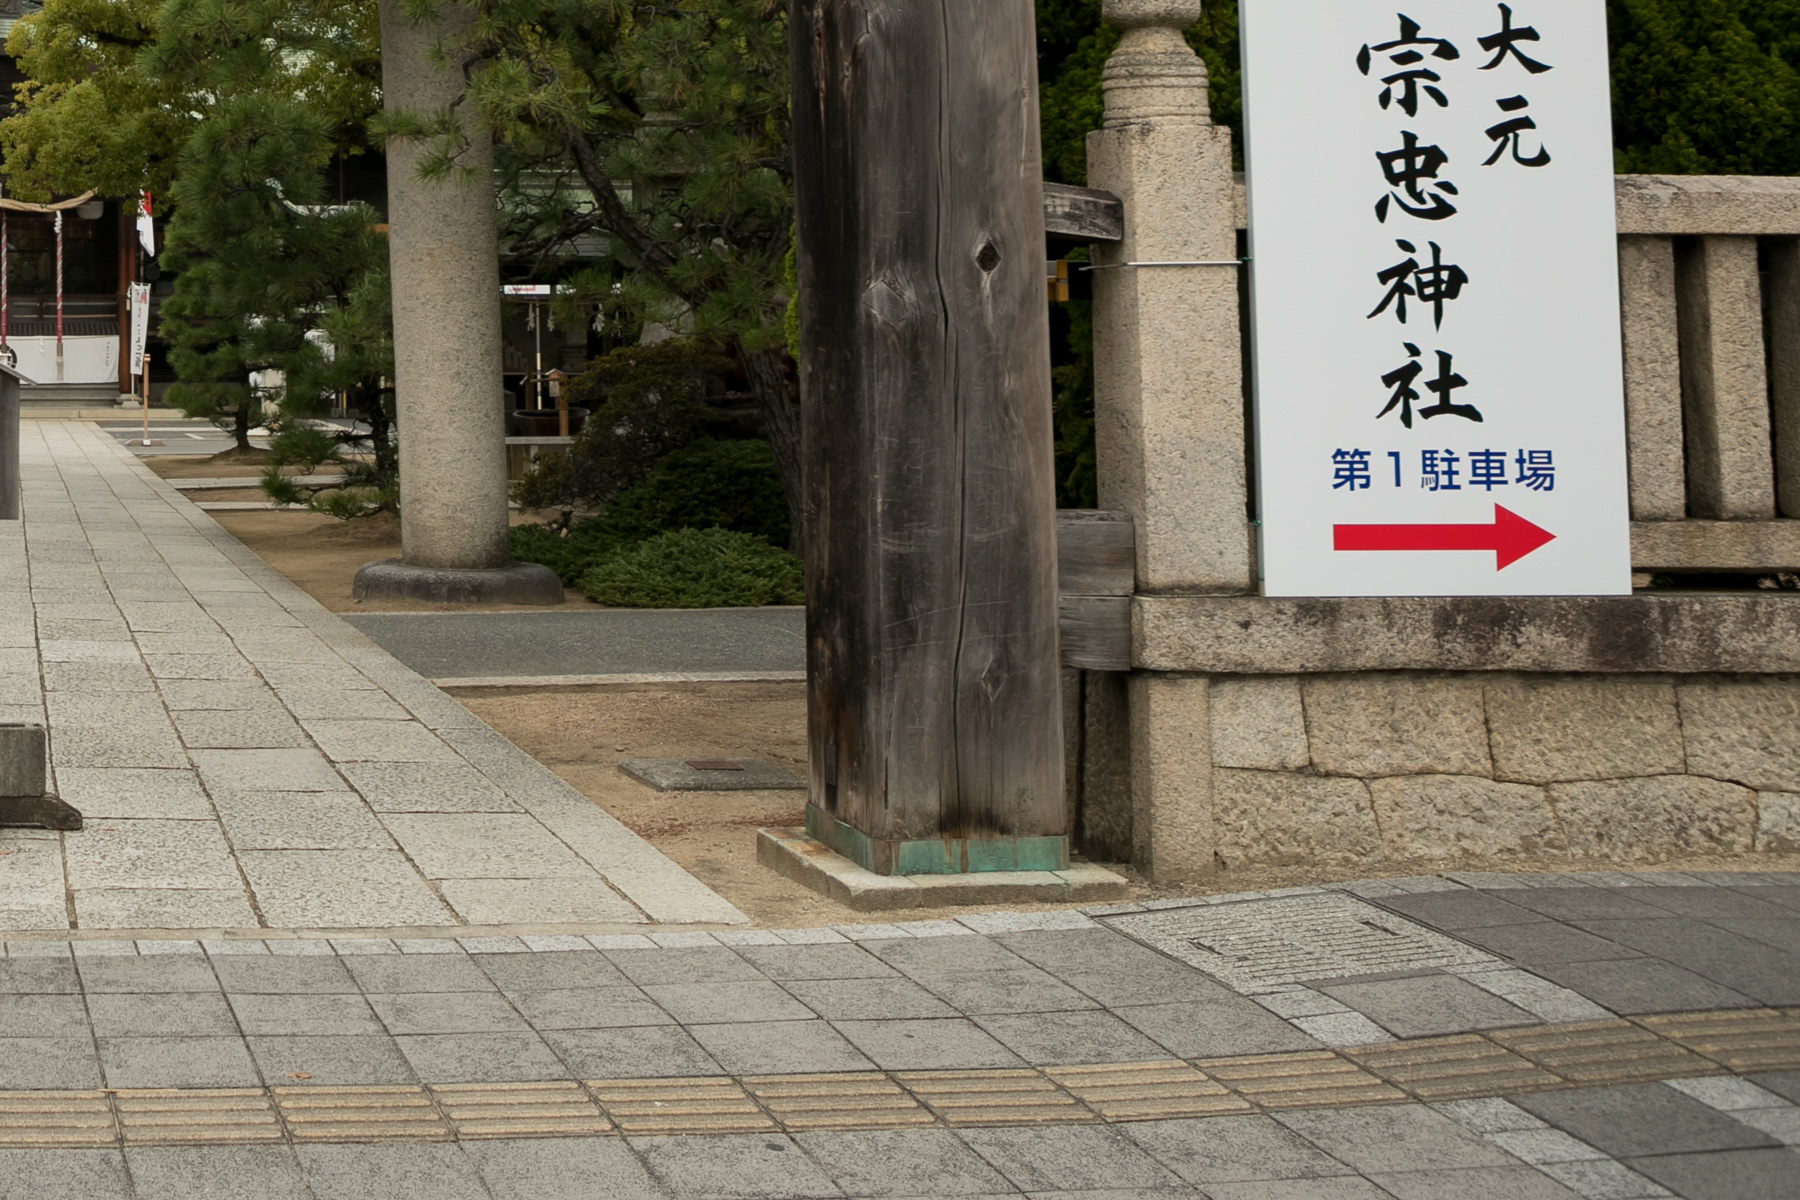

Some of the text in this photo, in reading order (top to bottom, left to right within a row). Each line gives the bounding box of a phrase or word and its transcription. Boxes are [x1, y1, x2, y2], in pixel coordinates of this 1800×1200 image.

[1356, 13, 1484, 429] 宗忠神社
[1476, 2, 1554, 168] 大元
